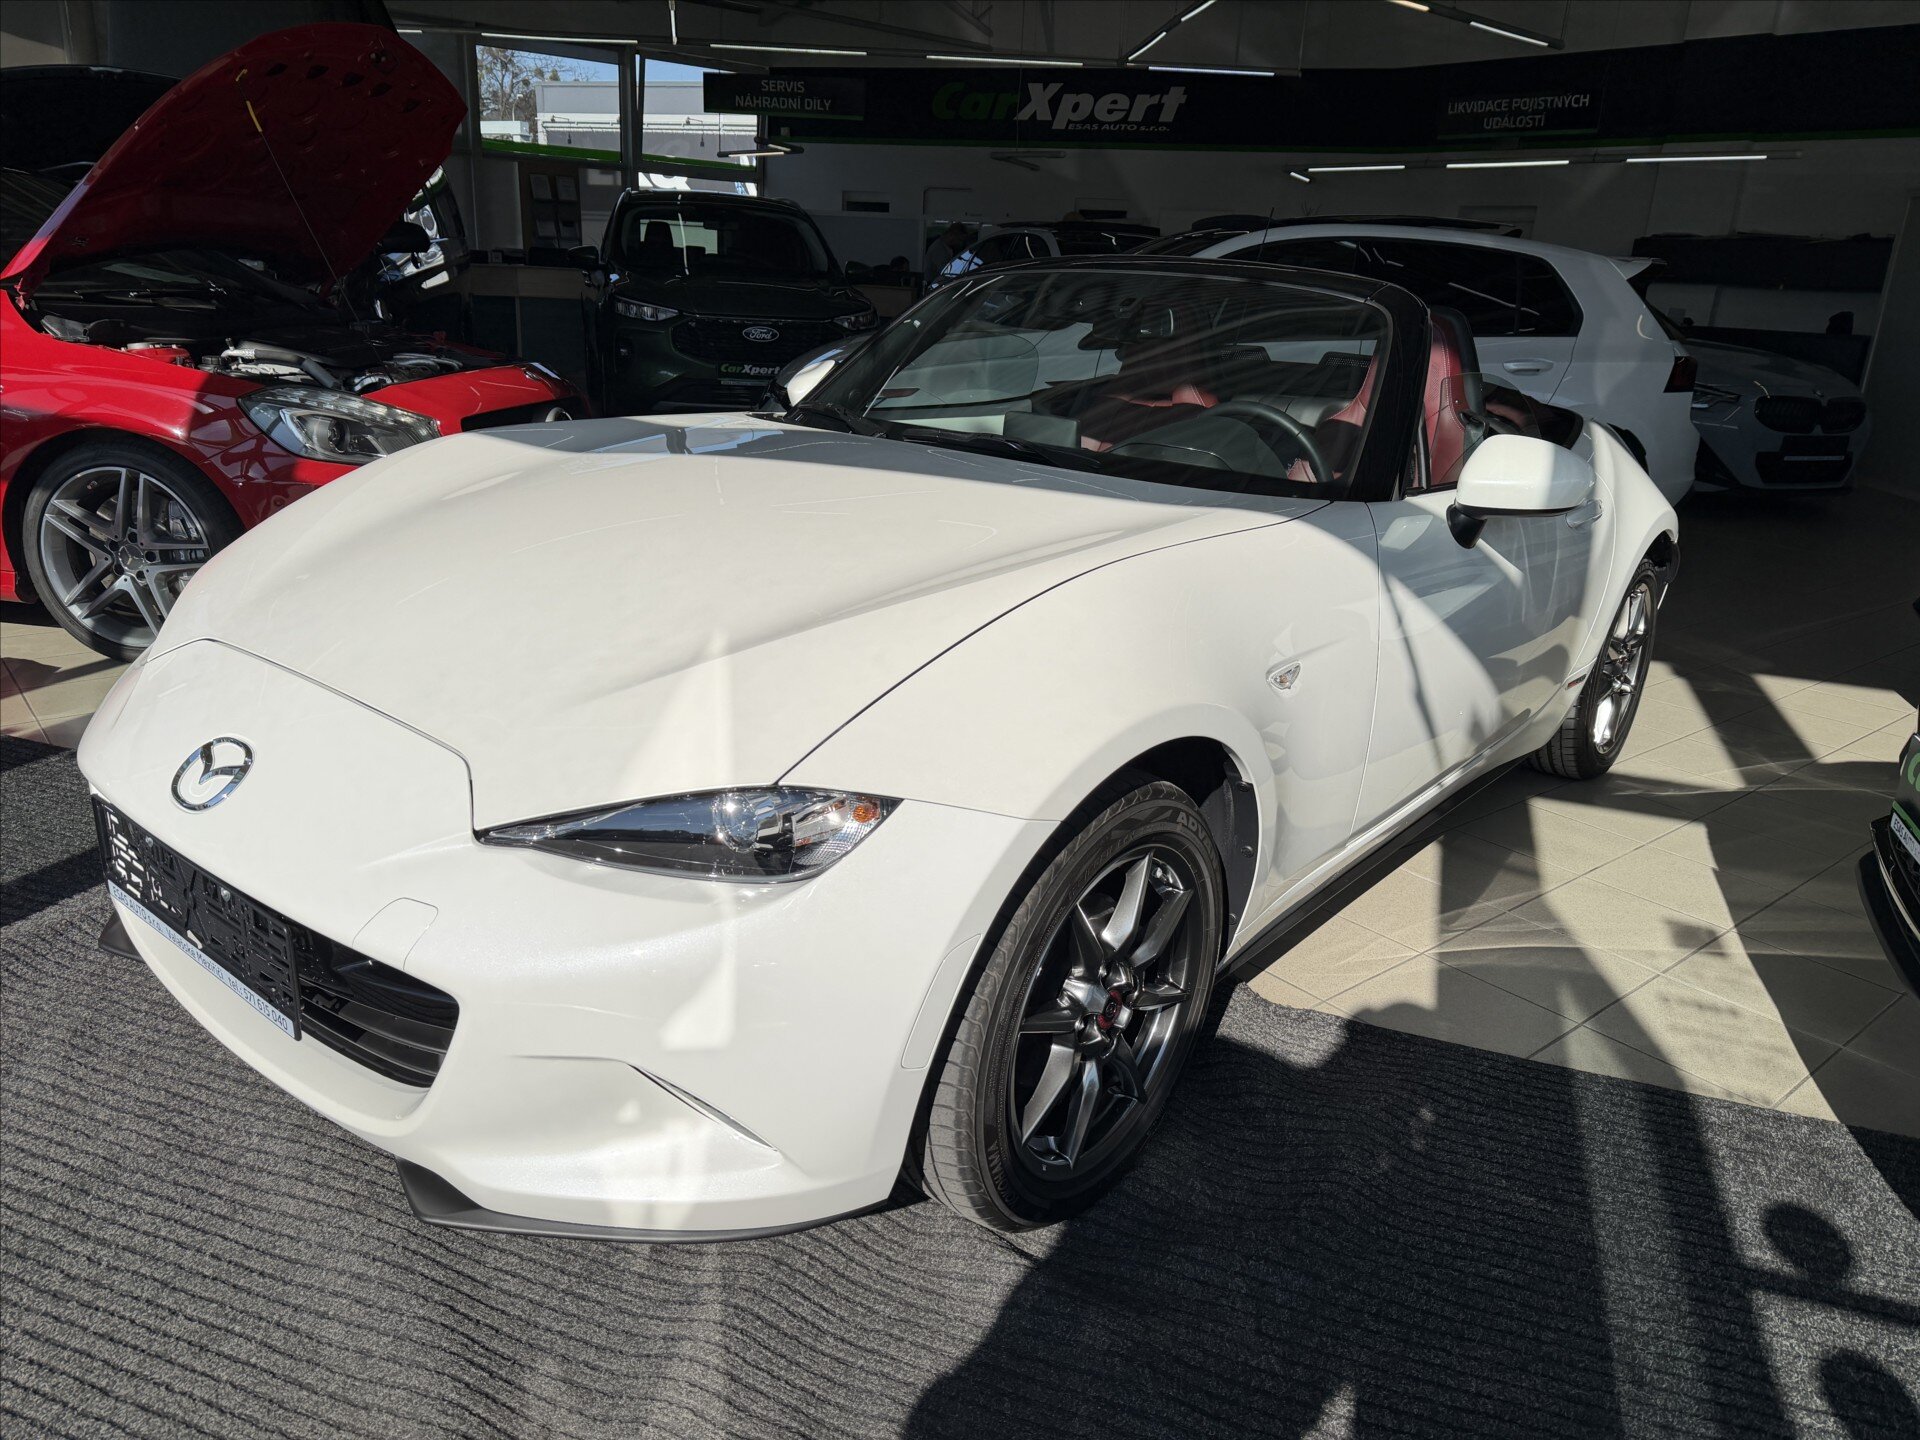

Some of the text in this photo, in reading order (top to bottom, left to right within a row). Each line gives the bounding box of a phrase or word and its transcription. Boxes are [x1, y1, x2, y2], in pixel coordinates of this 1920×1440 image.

[761, 80, 805, 93] SERVIS
[735, 92, 832, 111] NÁHRADNÍ DÍLY
[931, 81, 1188, 130] CarXpert
[1448, 93, 1590, 114] LIKVIDACE POJISTNÝCH
[1068, 123, 1099, 131] ESAS
[1101, 124, 1138, 132] AUTO
[1483, 112, 1546, 129] UDÁLOSTÍ
[749, 328, 773, 340] Ford
[720, 362, 781, 376] CarXpert
[244, 988, 256, 1006] 571
[258, 999, 270, 1016] 615
[272, 1009, 288, 1030] 040
